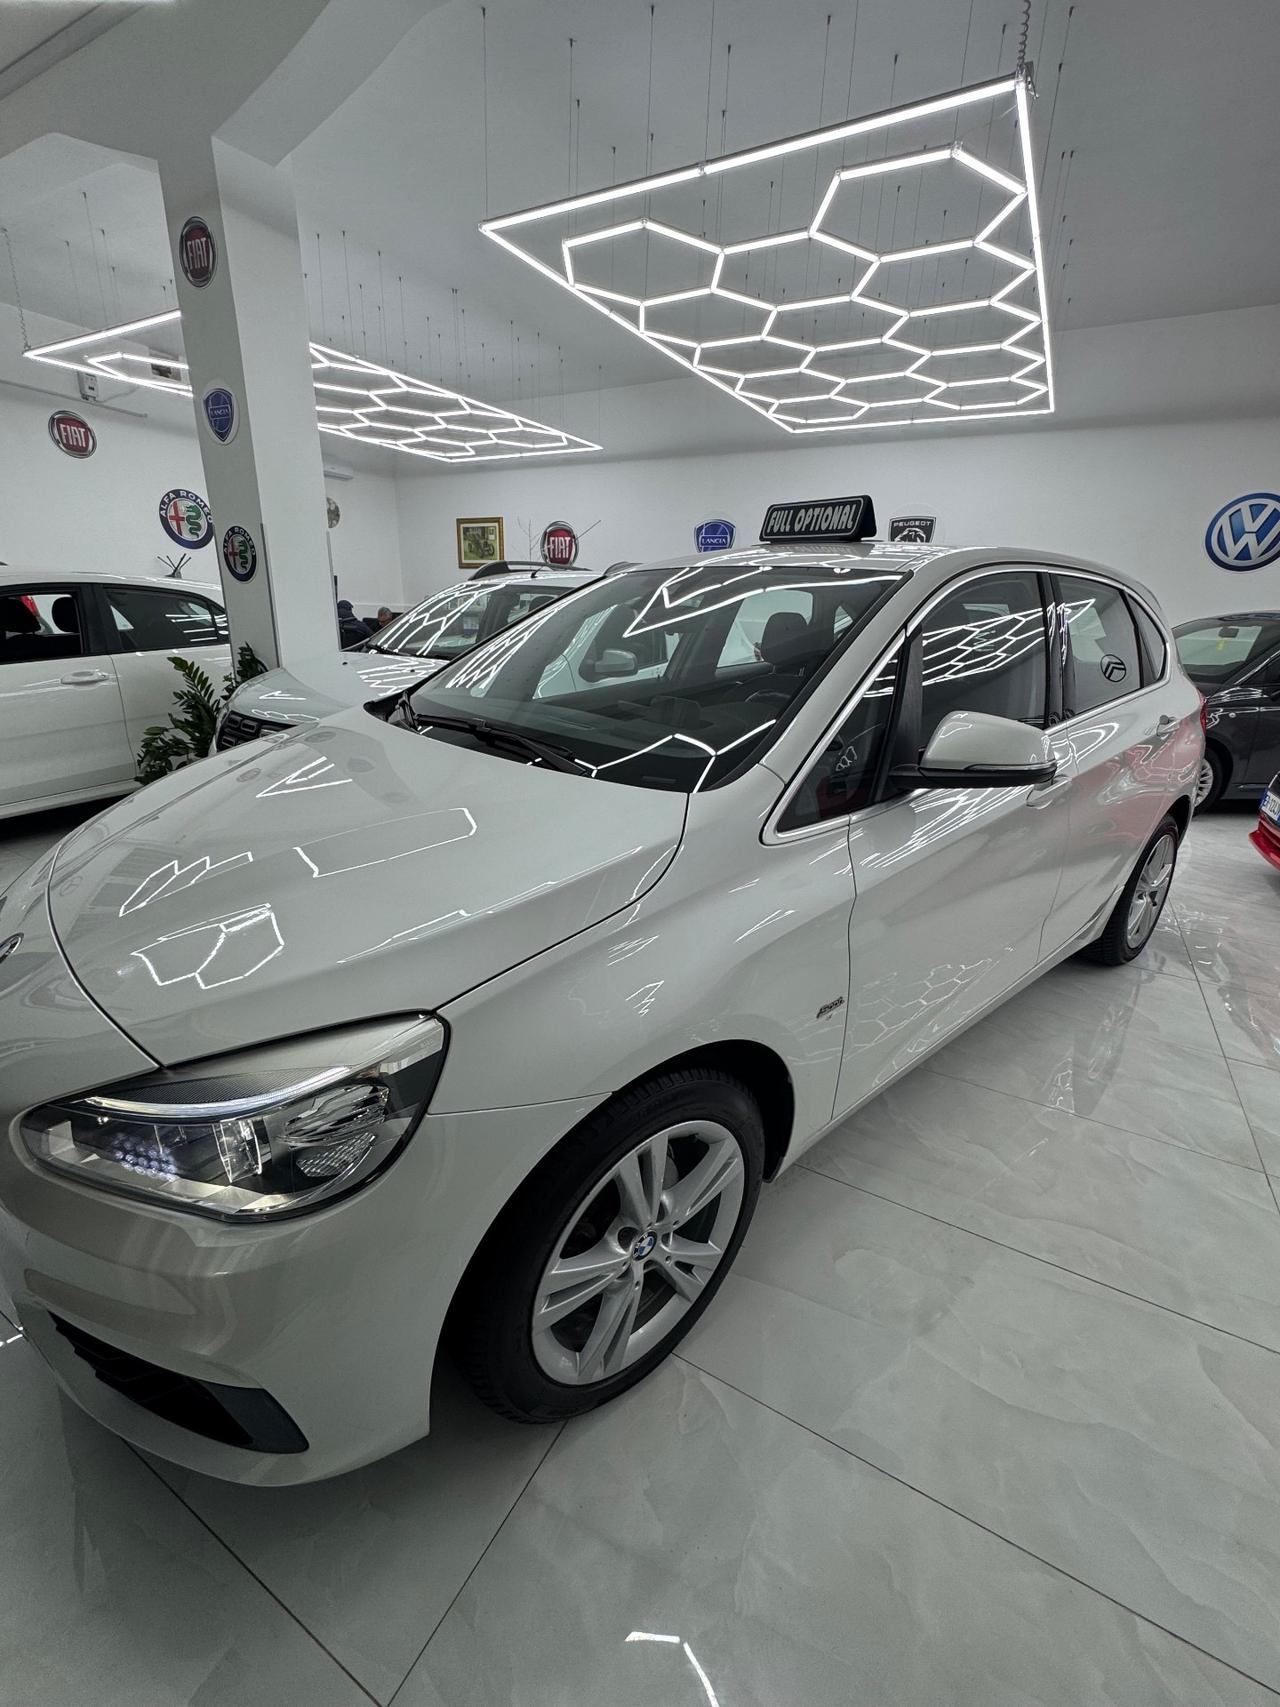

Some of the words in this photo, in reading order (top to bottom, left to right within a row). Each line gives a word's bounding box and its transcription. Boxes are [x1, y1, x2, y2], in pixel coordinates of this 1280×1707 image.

[187, 237, 208, 270] FIAT
[60, 423, 86, 448] FIAT
[160, 492, 177, 518] ALFA
[180, 490, 213, 523] ROMEO
[767, 509, 794, 534] FULL
[794, 503, 857, 533] OPTIONAL
[549, 536, 571, 559] FIAT
[701, 537, 728, 545] LANCIA
